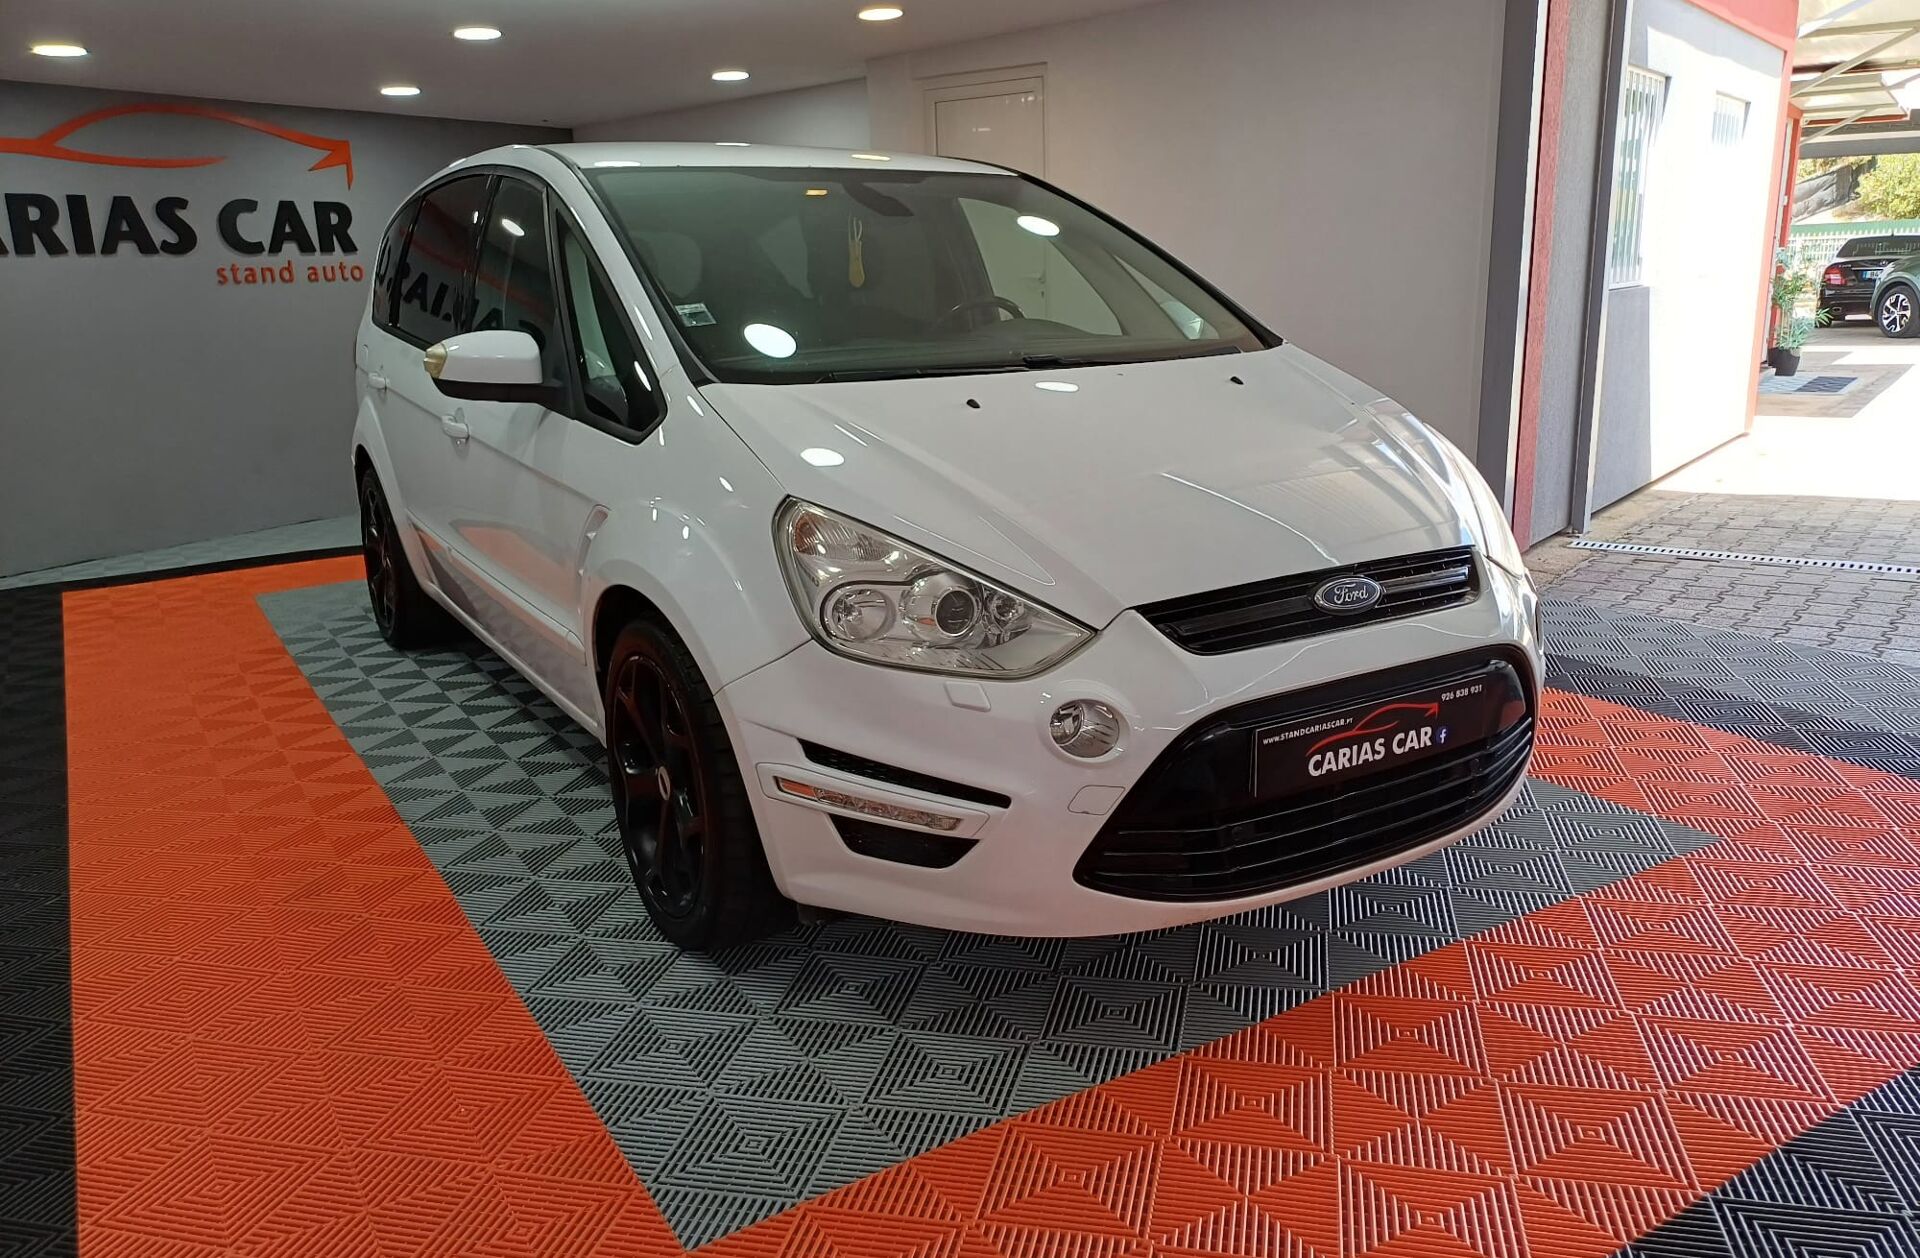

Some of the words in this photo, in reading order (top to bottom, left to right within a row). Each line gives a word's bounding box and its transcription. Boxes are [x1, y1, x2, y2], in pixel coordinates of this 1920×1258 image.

[0, 193, 197, 255] RIAS
[218, 199, 358, 254] CAR
[216, 260, 294, 284] stand
[306, 262, 364, 282] auto
[1334, 583, 1368, 604] Ford
[1441, 691, 1454, 701] 926
[1456, 688, 1468, 697] 838
[1470, 684, 1482, 694] 931
[1308, 738, 1385, 776] CARIAS
[1392, 726, 1432, 754] CAR
